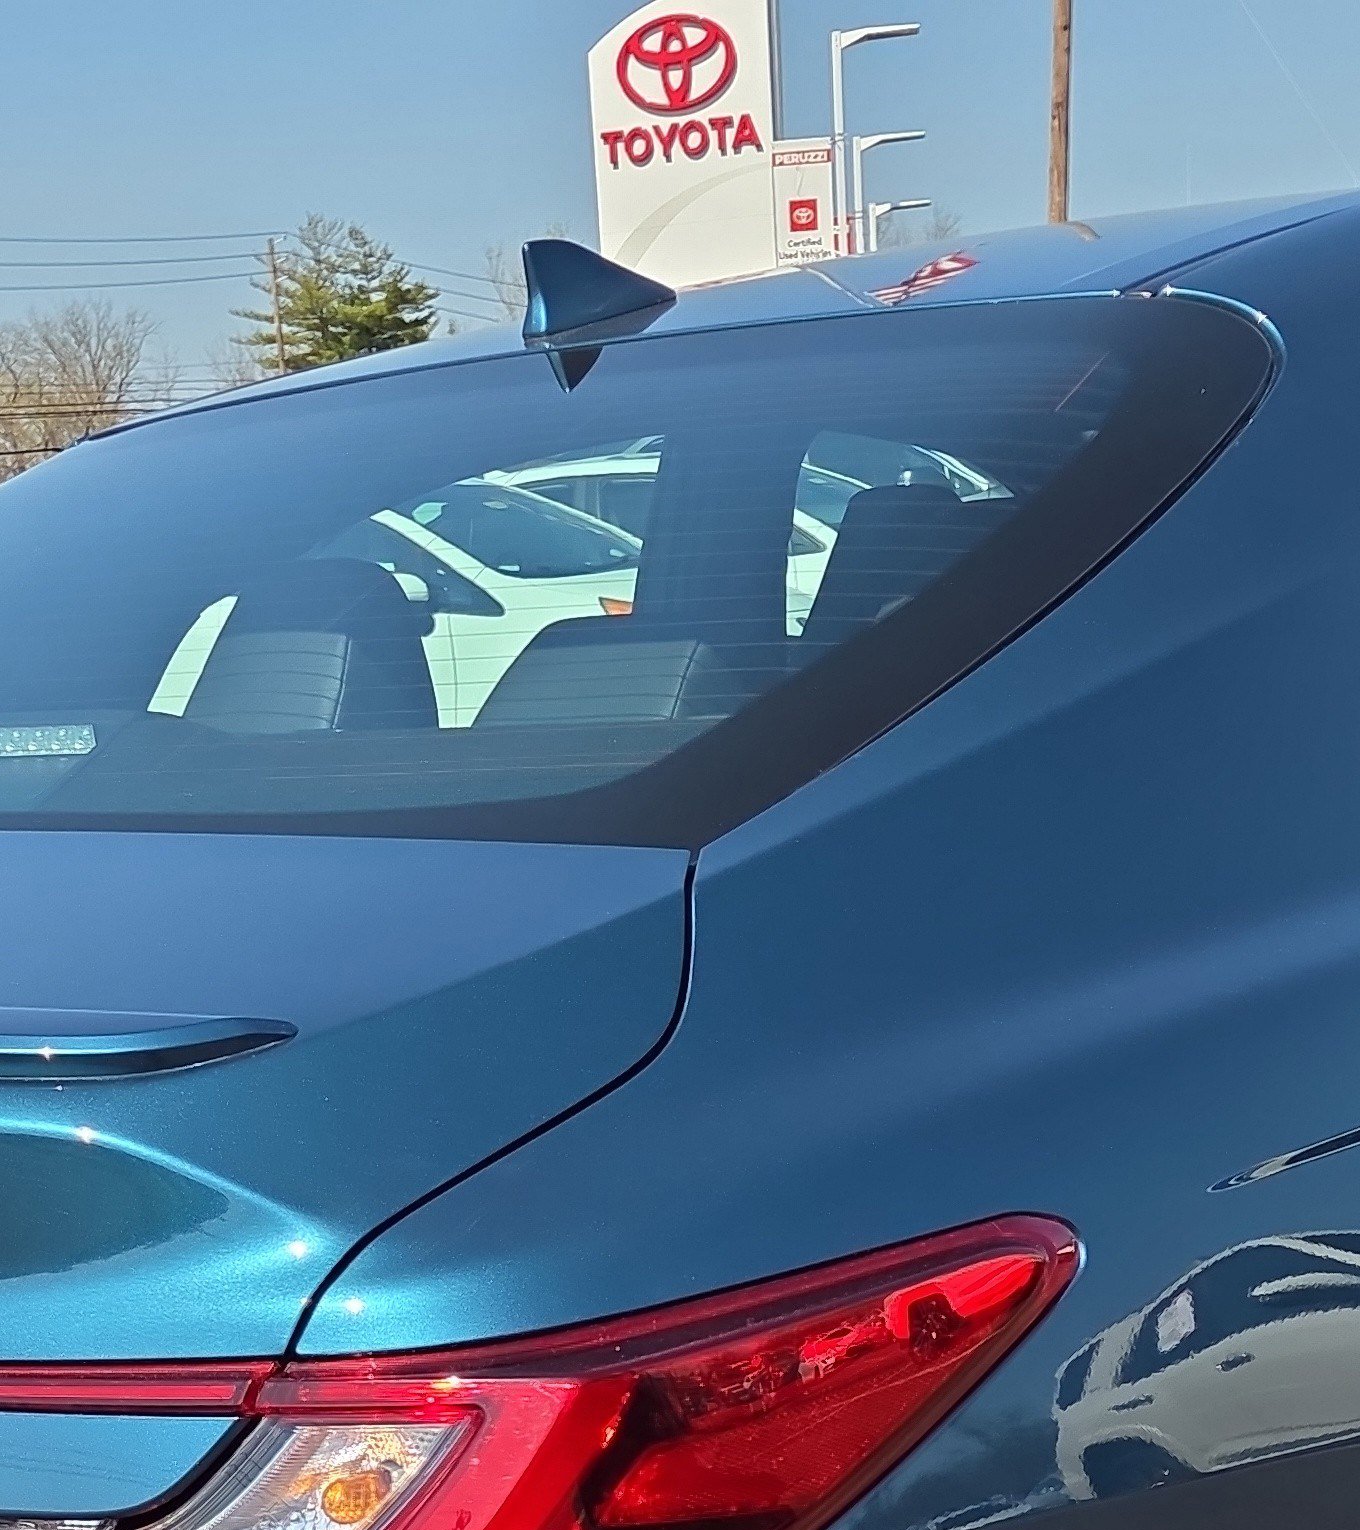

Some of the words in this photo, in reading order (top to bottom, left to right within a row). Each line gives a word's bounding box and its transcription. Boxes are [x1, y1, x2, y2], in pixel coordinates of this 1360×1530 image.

[601, 113, 764, 170] TOYOTA
[774, 151, 828, 166] PERUZZI
[787, 237, 823, 248] Certified
[778, 250, 798, 260] Used
